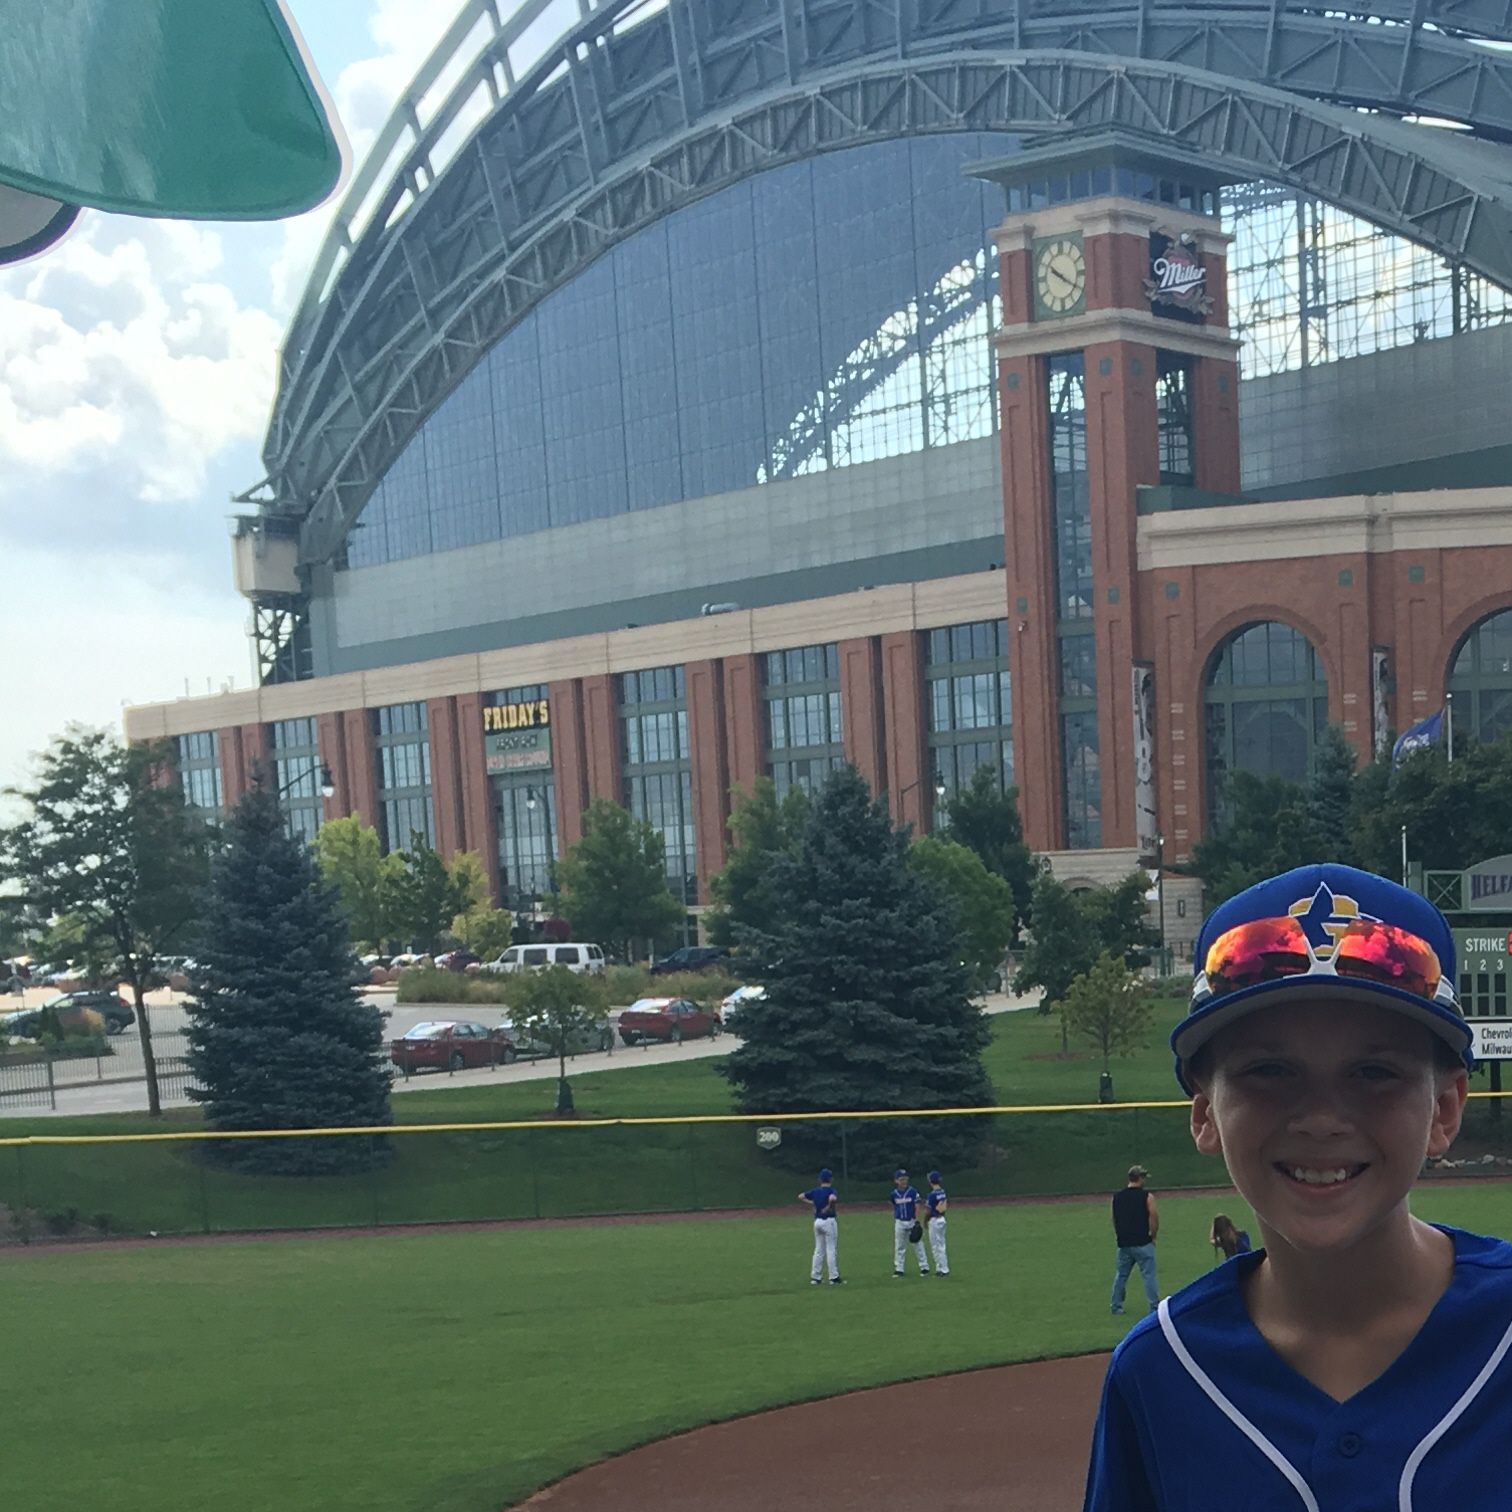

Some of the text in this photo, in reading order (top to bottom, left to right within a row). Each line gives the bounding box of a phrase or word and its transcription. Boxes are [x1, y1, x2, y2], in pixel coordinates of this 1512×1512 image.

[1154, 258, 1206, 289] Miller
[483, 700, 549, 731] FRIDAY'S
[1465, 937, 1506, 953] STRIKE
[1463, 957, 1469, 970] 1
[1480, 958, 1487, 971] 2
[1497, 958, 1504, 970] 3
